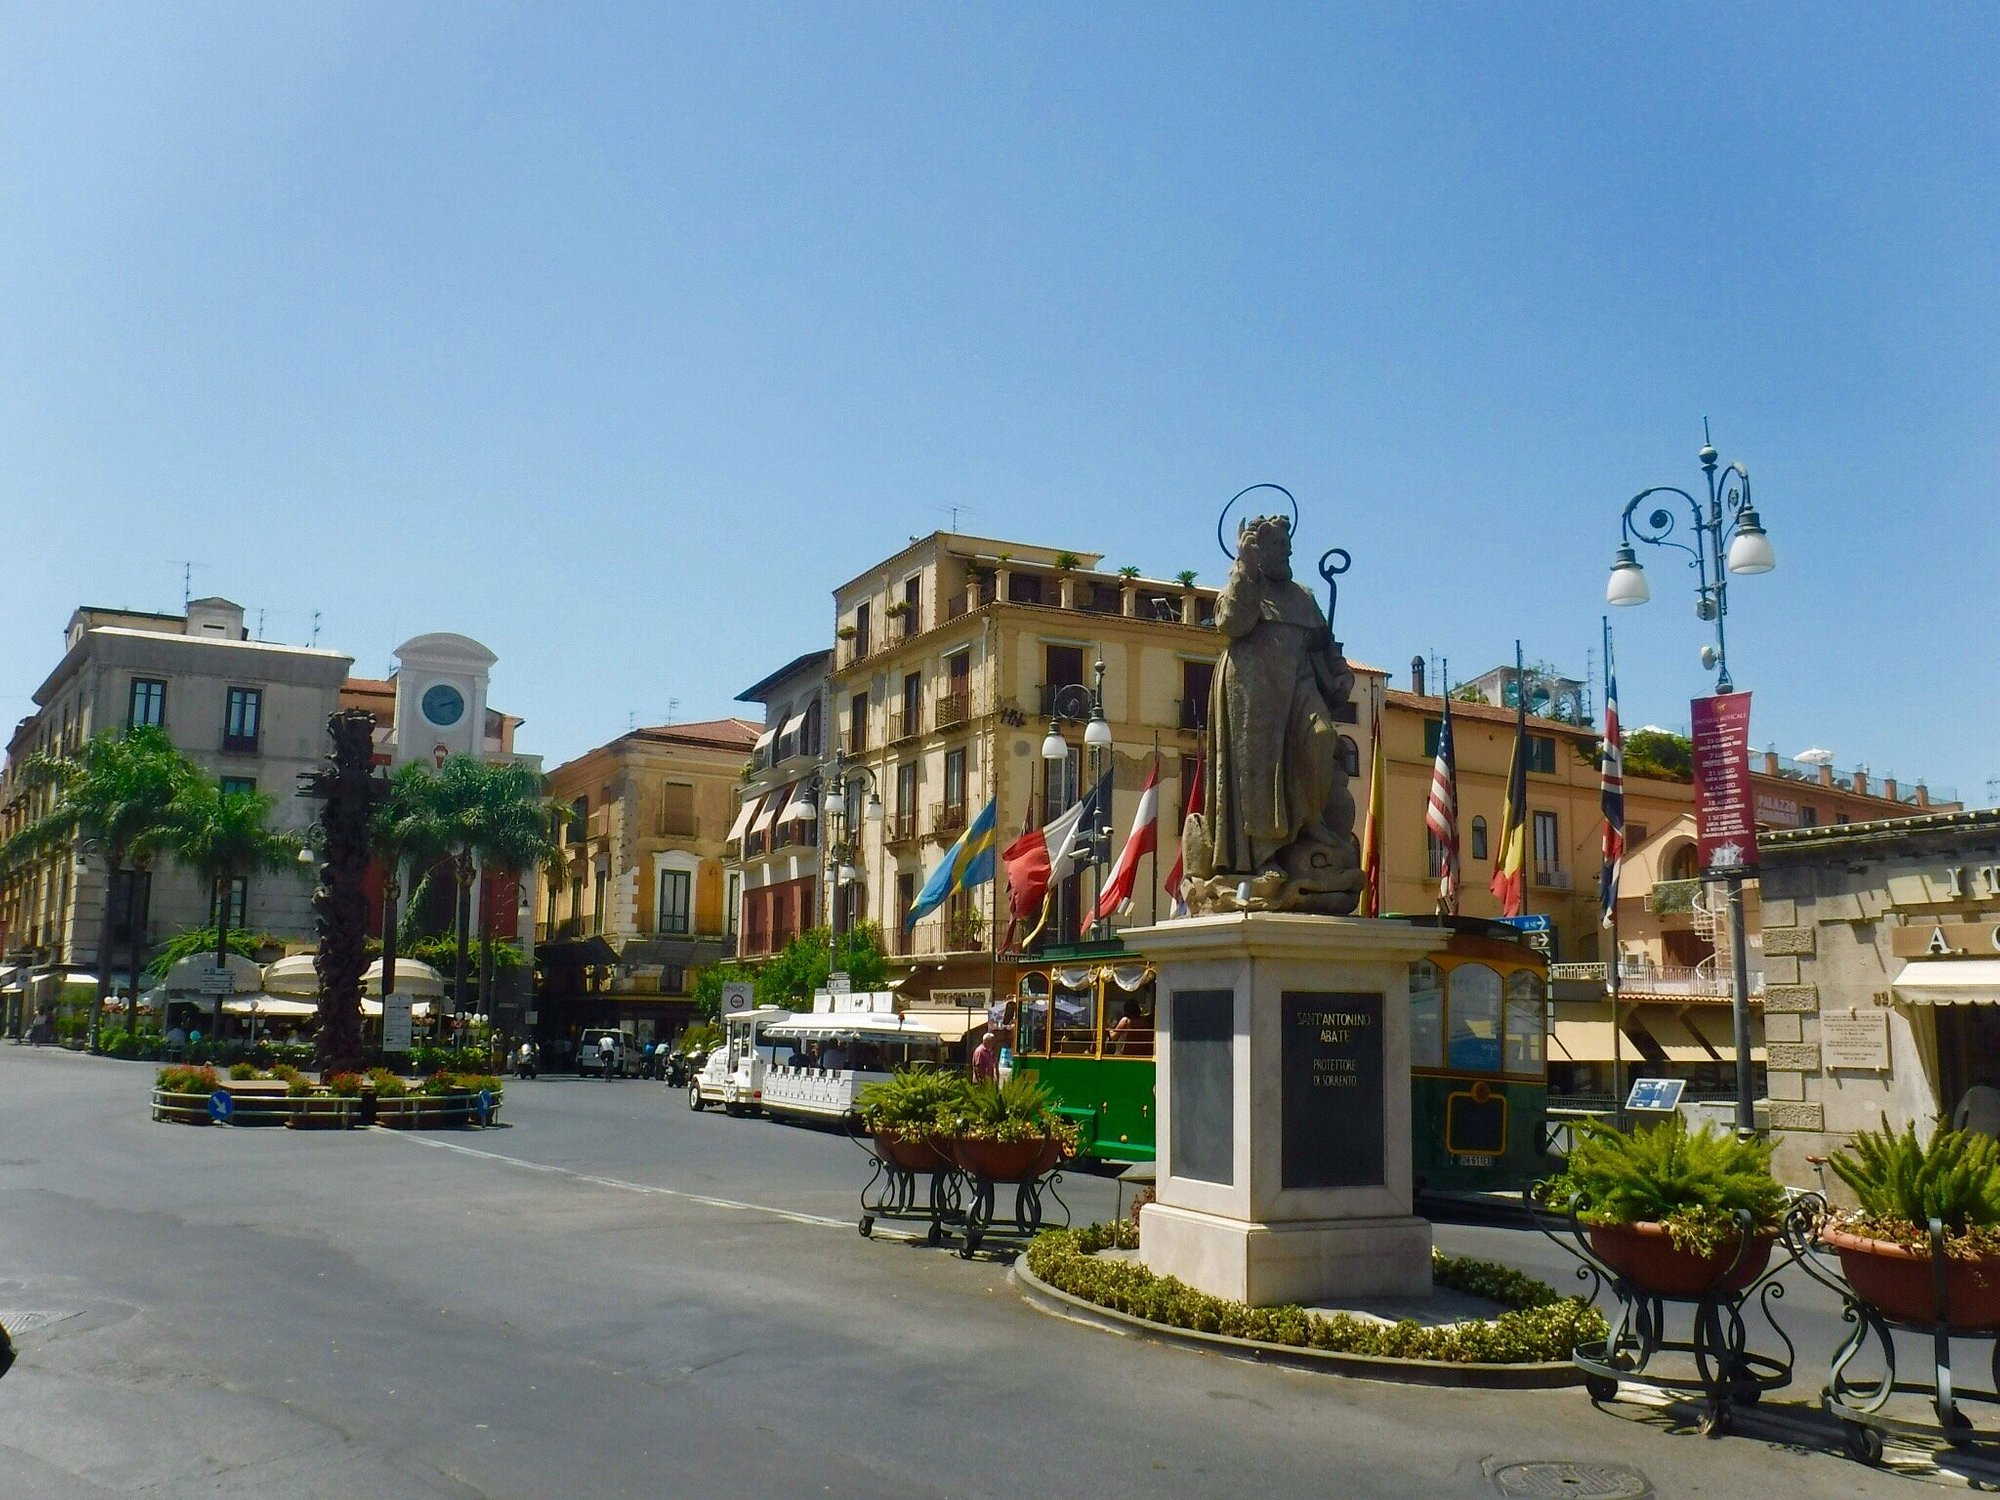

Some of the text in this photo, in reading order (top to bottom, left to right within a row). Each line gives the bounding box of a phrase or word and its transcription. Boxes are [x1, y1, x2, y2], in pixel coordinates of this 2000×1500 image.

[1320, 1029, 1350, 1043] ABATE
[1313, 1058, 1357, 1071] PROTETTORE
[1322, 1075, 1358, 1087] SORRENTO
